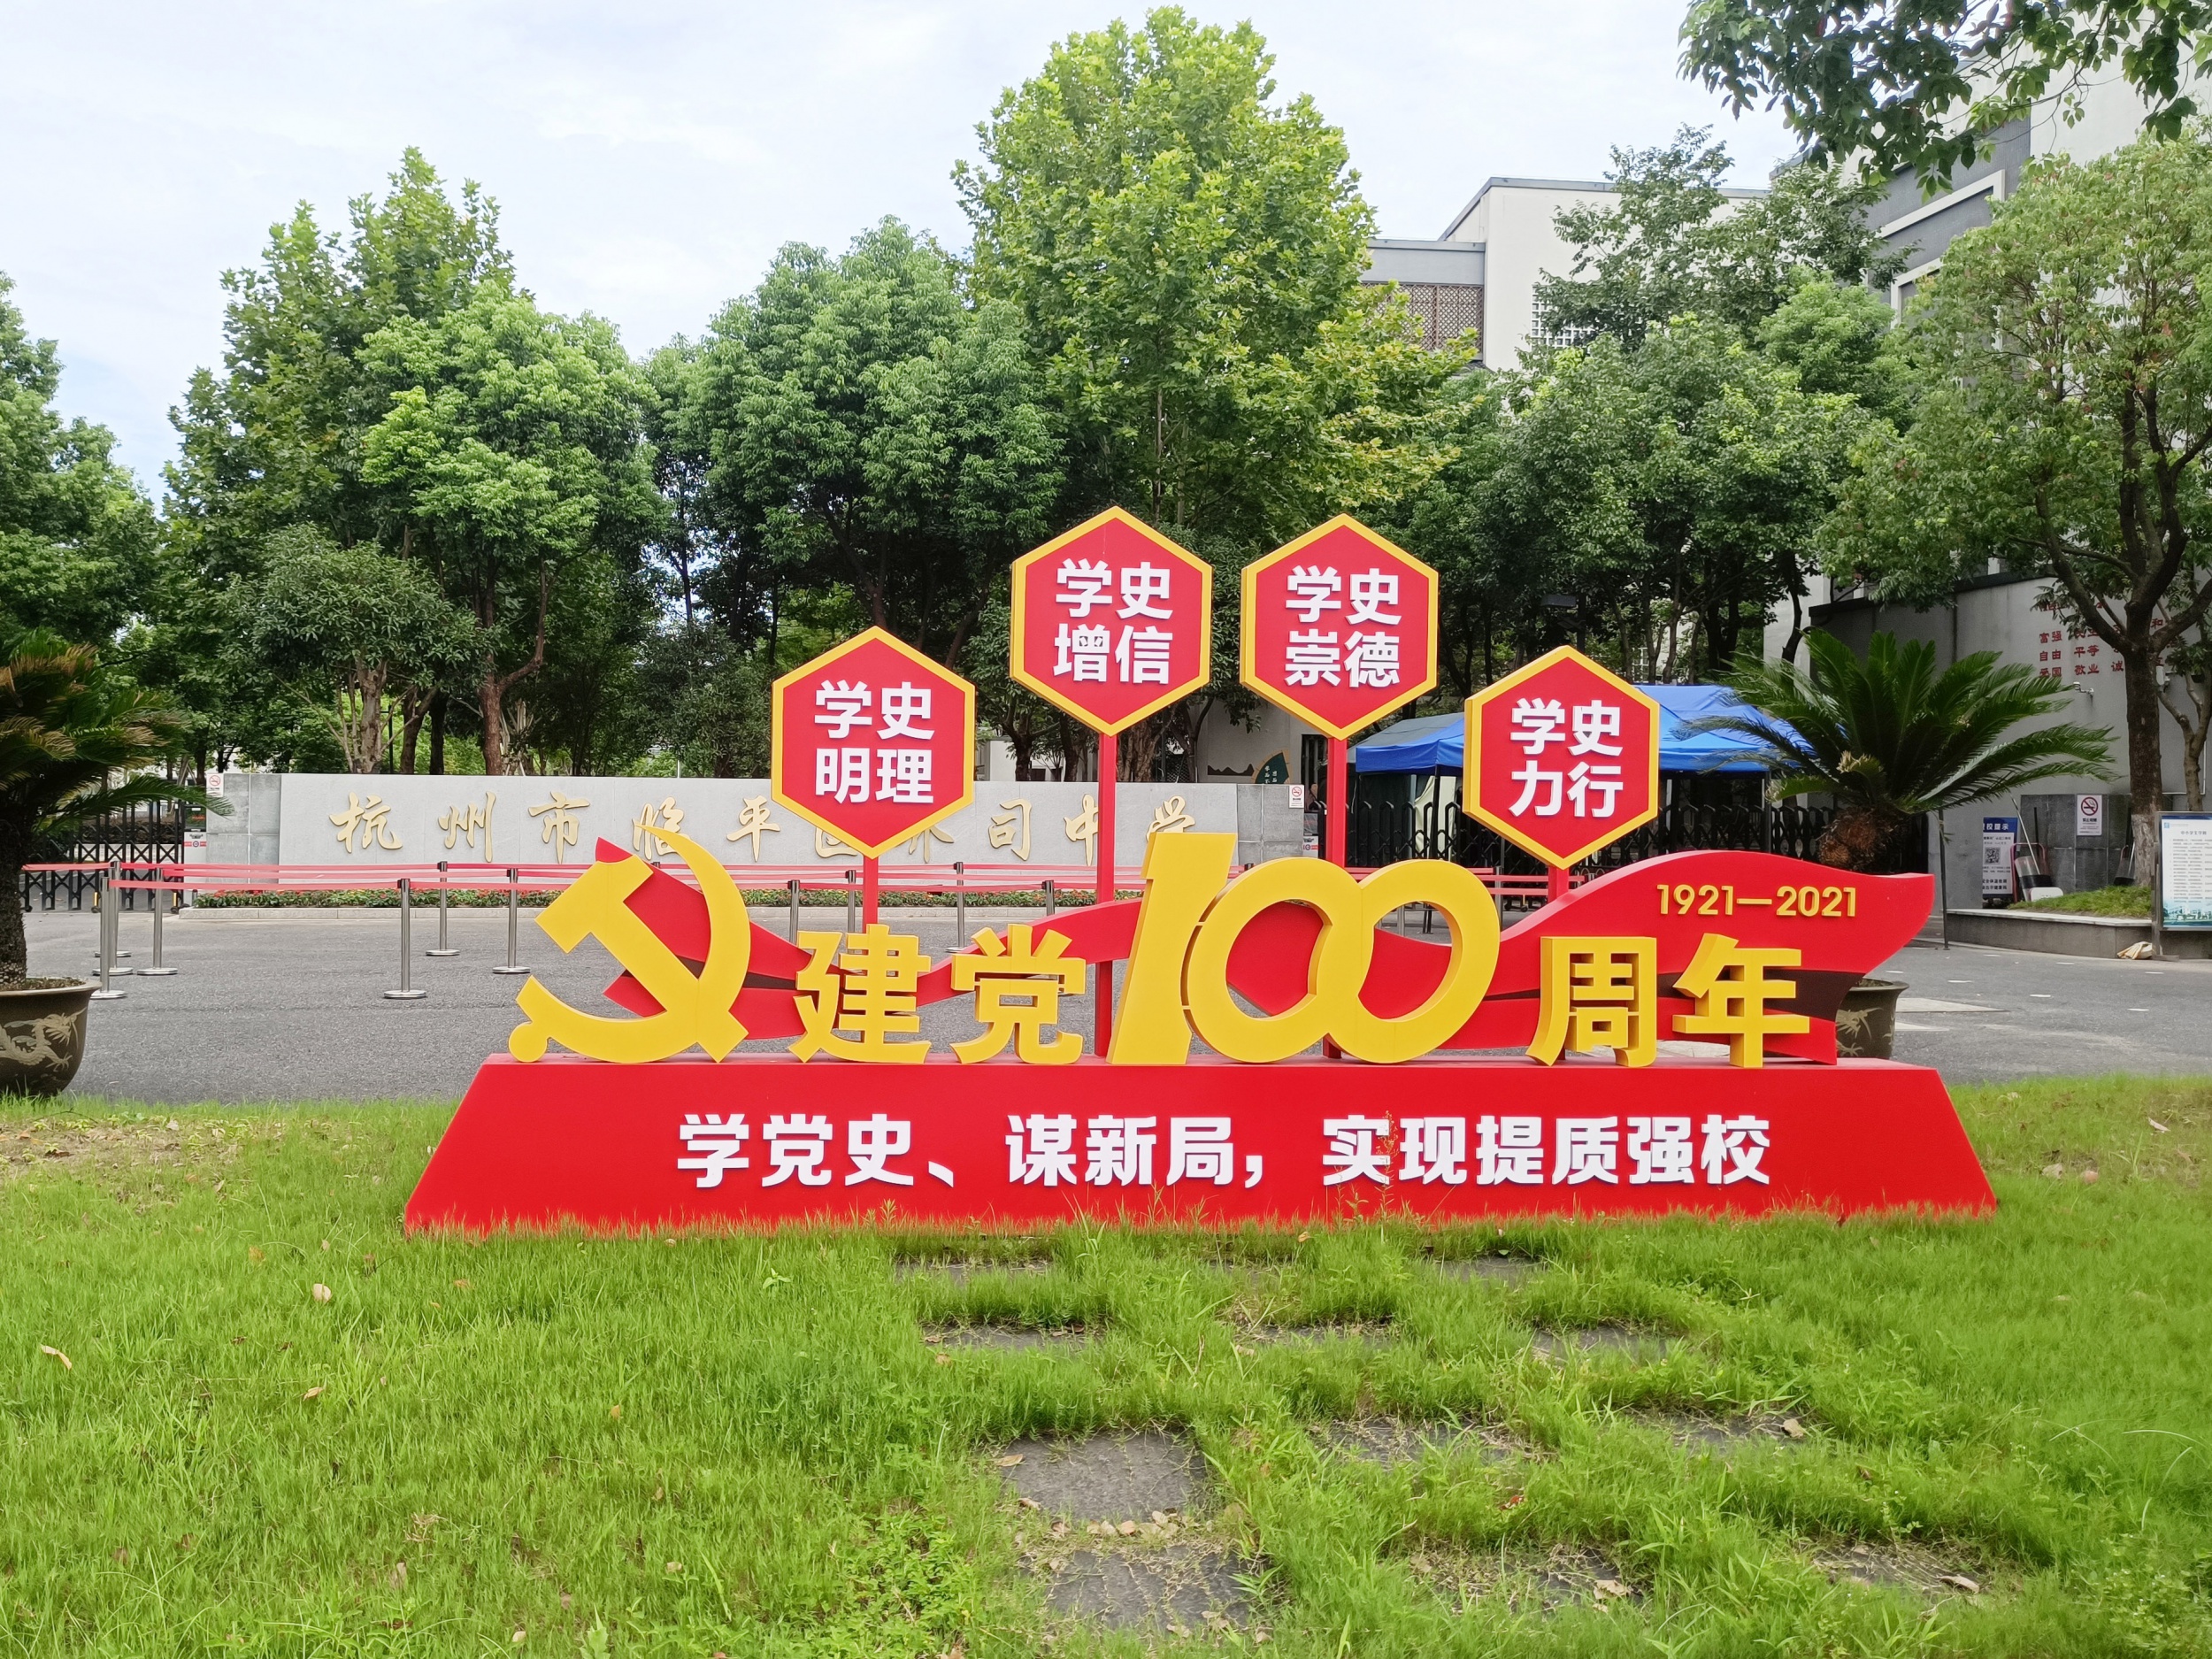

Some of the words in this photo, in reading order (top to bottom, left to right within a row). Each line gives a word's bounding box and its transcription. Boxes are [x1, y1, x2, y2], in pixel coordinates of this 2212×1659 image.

[1056, 558, 1173, 619] 学史
[1286, 565, 1402, 626] 学史
[1053, 624, 1174, 686] 增信
[1285, 629, 1401, 688] 崇德
[2039, 630, 2062, 644] 富强
[2039, 649, 2062, 662] 自由
[2073, 645, 2100, 658] 平等
[2074, 663, 2100, 676] 敬业
[814, 680, 935, 741] 学史
[1510, 697, 1624, 757] 学史
[814, 748, 934, 805] 明理
[1509, 760, 1624, 818] 力行
